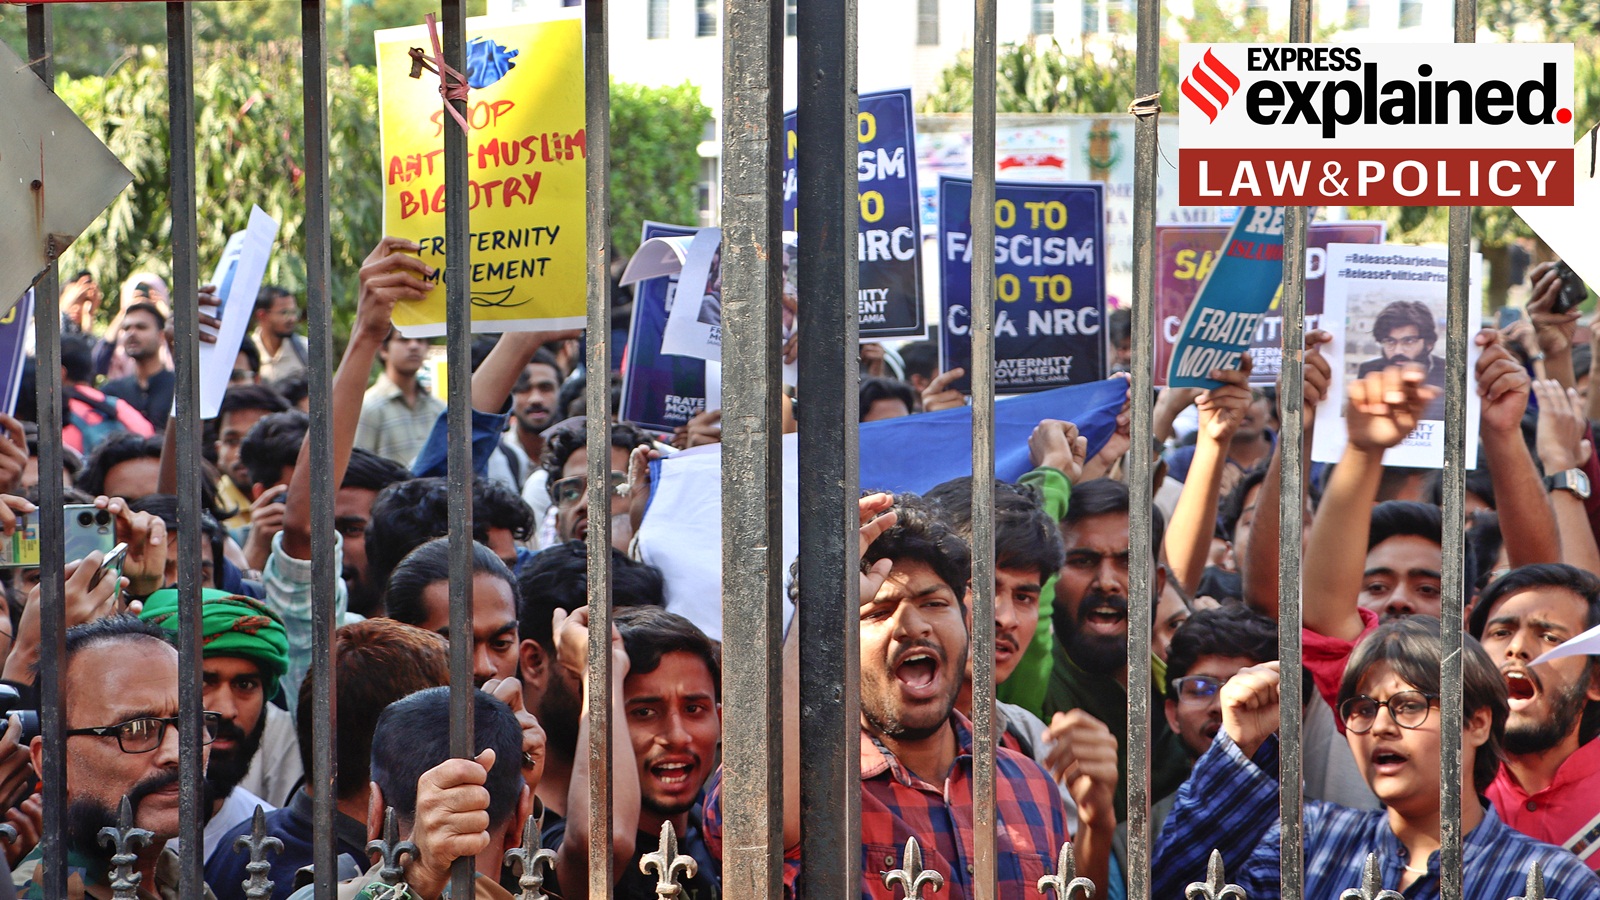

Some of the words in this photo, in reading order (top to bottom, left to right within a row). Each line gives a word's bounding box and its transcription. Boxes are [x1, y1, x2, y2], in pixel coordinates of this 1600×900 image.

[429, 99, 515, 137] SOP
[388, 128, 586, 185] ANT-MUSLIM
[1024, 200, 1068, 231] TO
[946, 231, 1094, 267] FSCISM
[423, 257, 551, 286] MEMENT
[1028, 273, 1073, 304] TO
[947, 304, 1018, 338] CA
[1028, 306, 1101, 337] NRC
[995, 365, 1072, 378] OVEMENT
